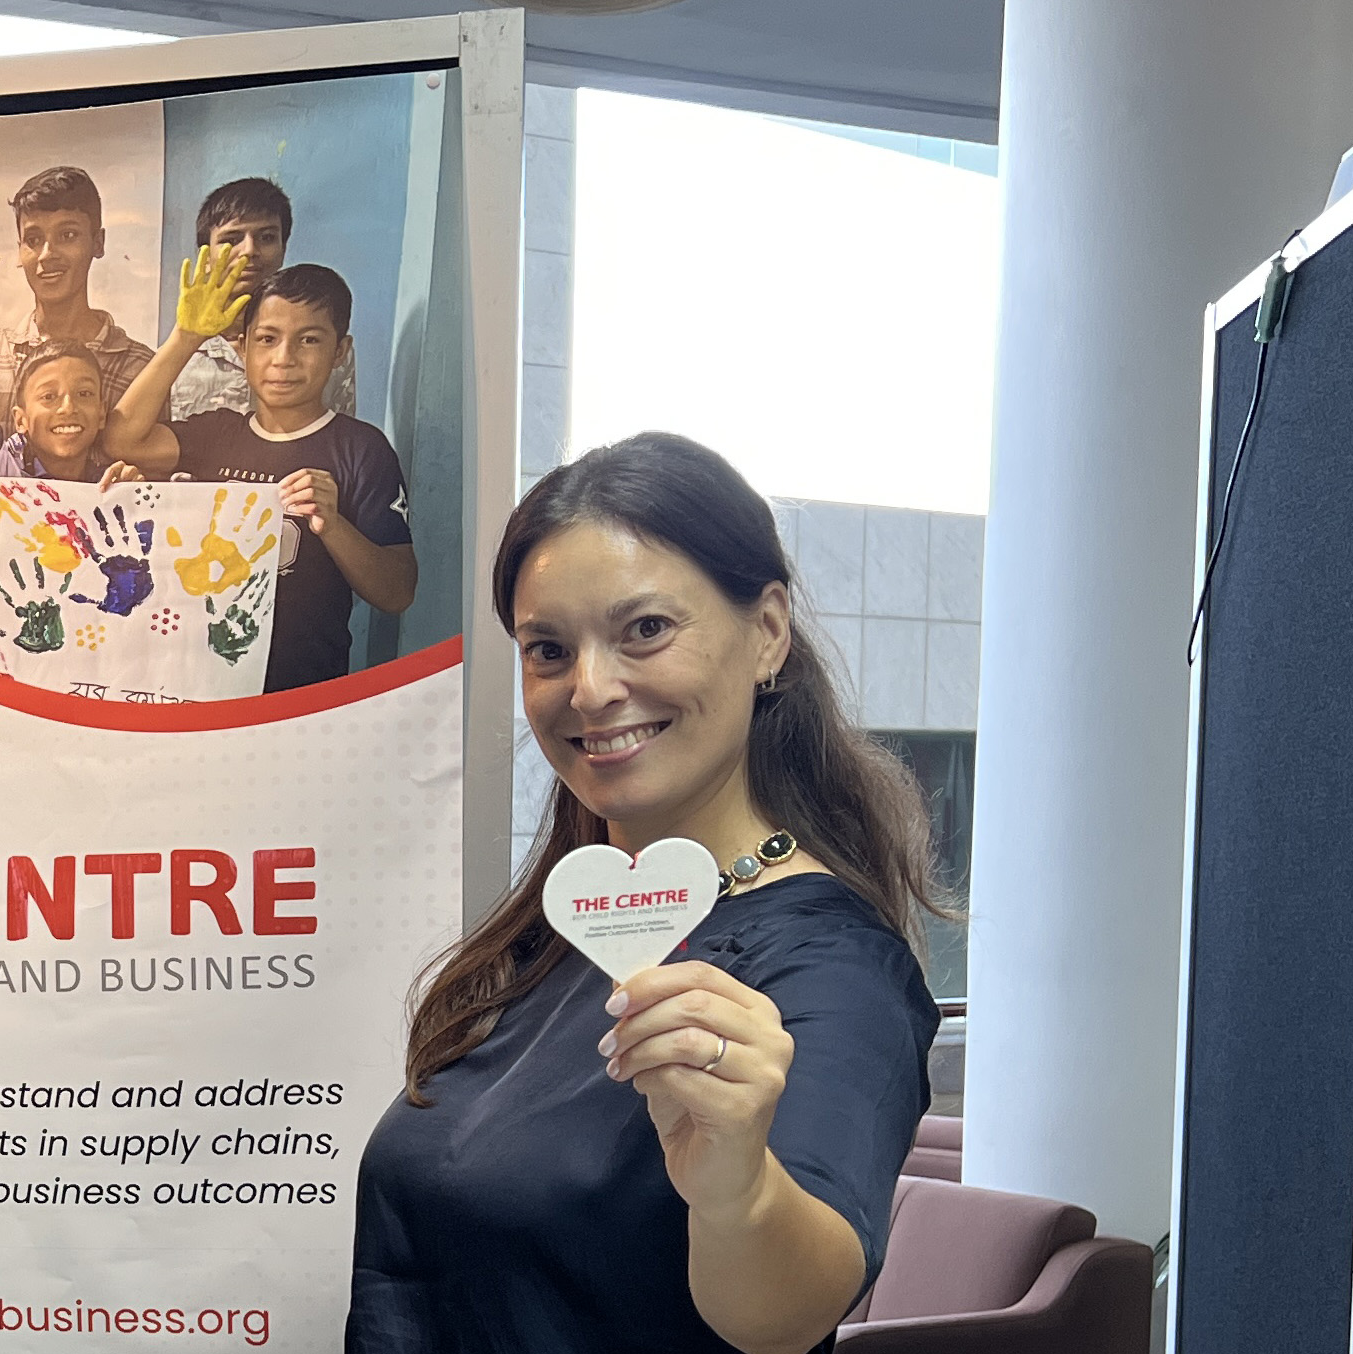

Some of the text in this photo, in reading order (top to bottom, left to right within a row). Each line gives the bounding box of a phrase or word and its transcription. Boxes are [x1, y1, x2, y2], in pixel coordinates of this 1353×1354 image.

[573, 888, 686, 913] THE CENTRE
[101, 954, 315, 992] BUSINESS
[112, 1079, 183, 1108] and
[194, 1078, 344, 1107] address
[40, 1128, 68, 1156] in
[80, 1128, 201, 1163] supply
[212, 1126, 339, 1159] chains,
[153, 1179, 337, 1205] outcomes
